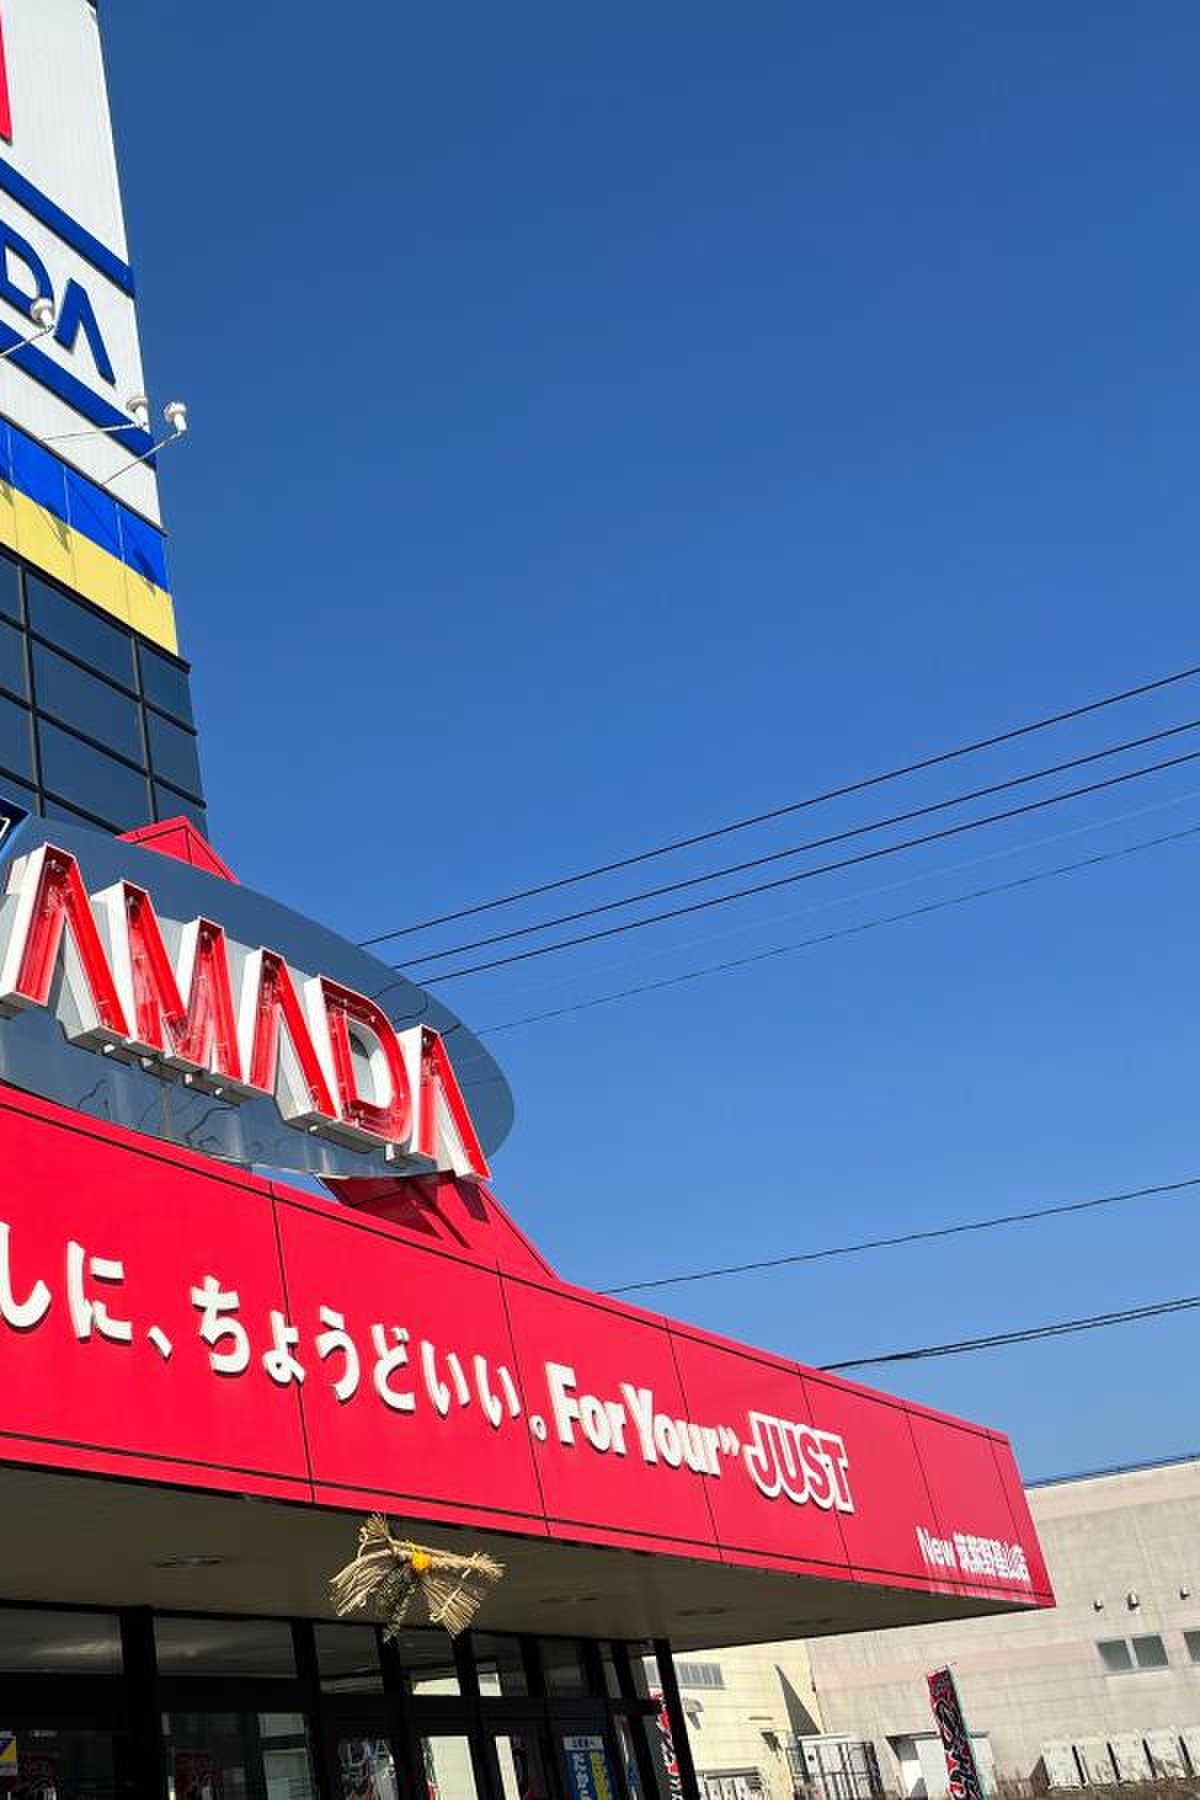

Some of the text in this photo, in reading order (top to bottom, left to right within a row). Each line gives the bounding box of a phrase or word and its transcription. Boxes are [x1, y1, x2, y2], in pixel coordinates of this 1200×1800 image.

[544, 1361, 625, 1457] For
[742, 1410, 854, 1514] JUST
[915, 1526, 956, 1568] New
